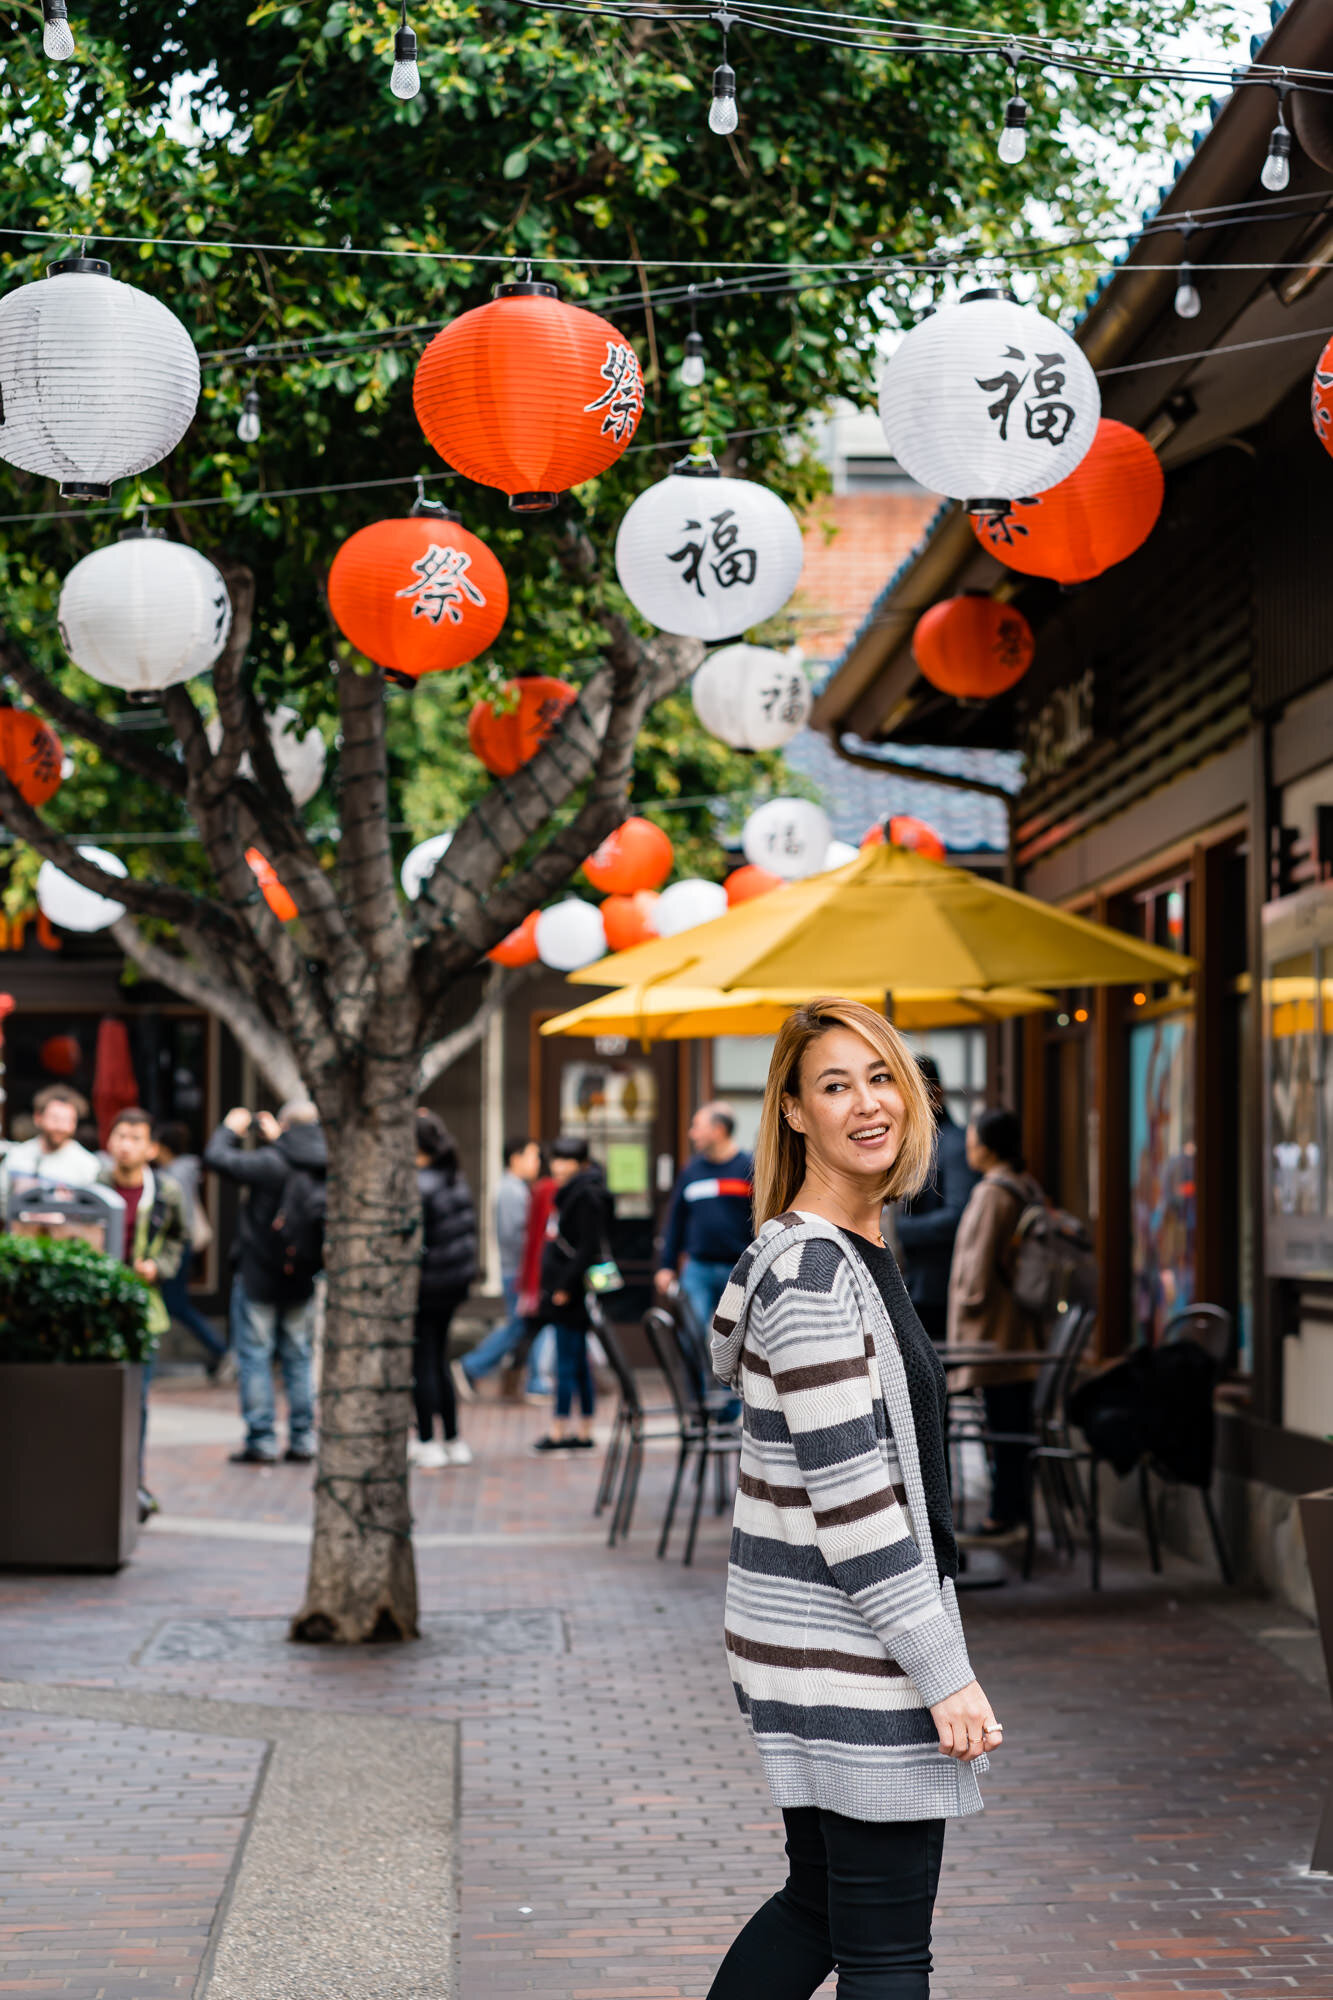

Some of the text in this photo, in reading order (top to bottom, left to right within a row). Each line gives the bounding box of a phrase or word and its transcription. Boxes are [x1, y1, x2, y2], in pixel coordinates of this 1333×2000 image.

[583, 341, 645, 443] 祭
[974, 344, 1076, 446] 福
[395, 544, 487, 626] 祭
[664, 509, 757, 598] 福
